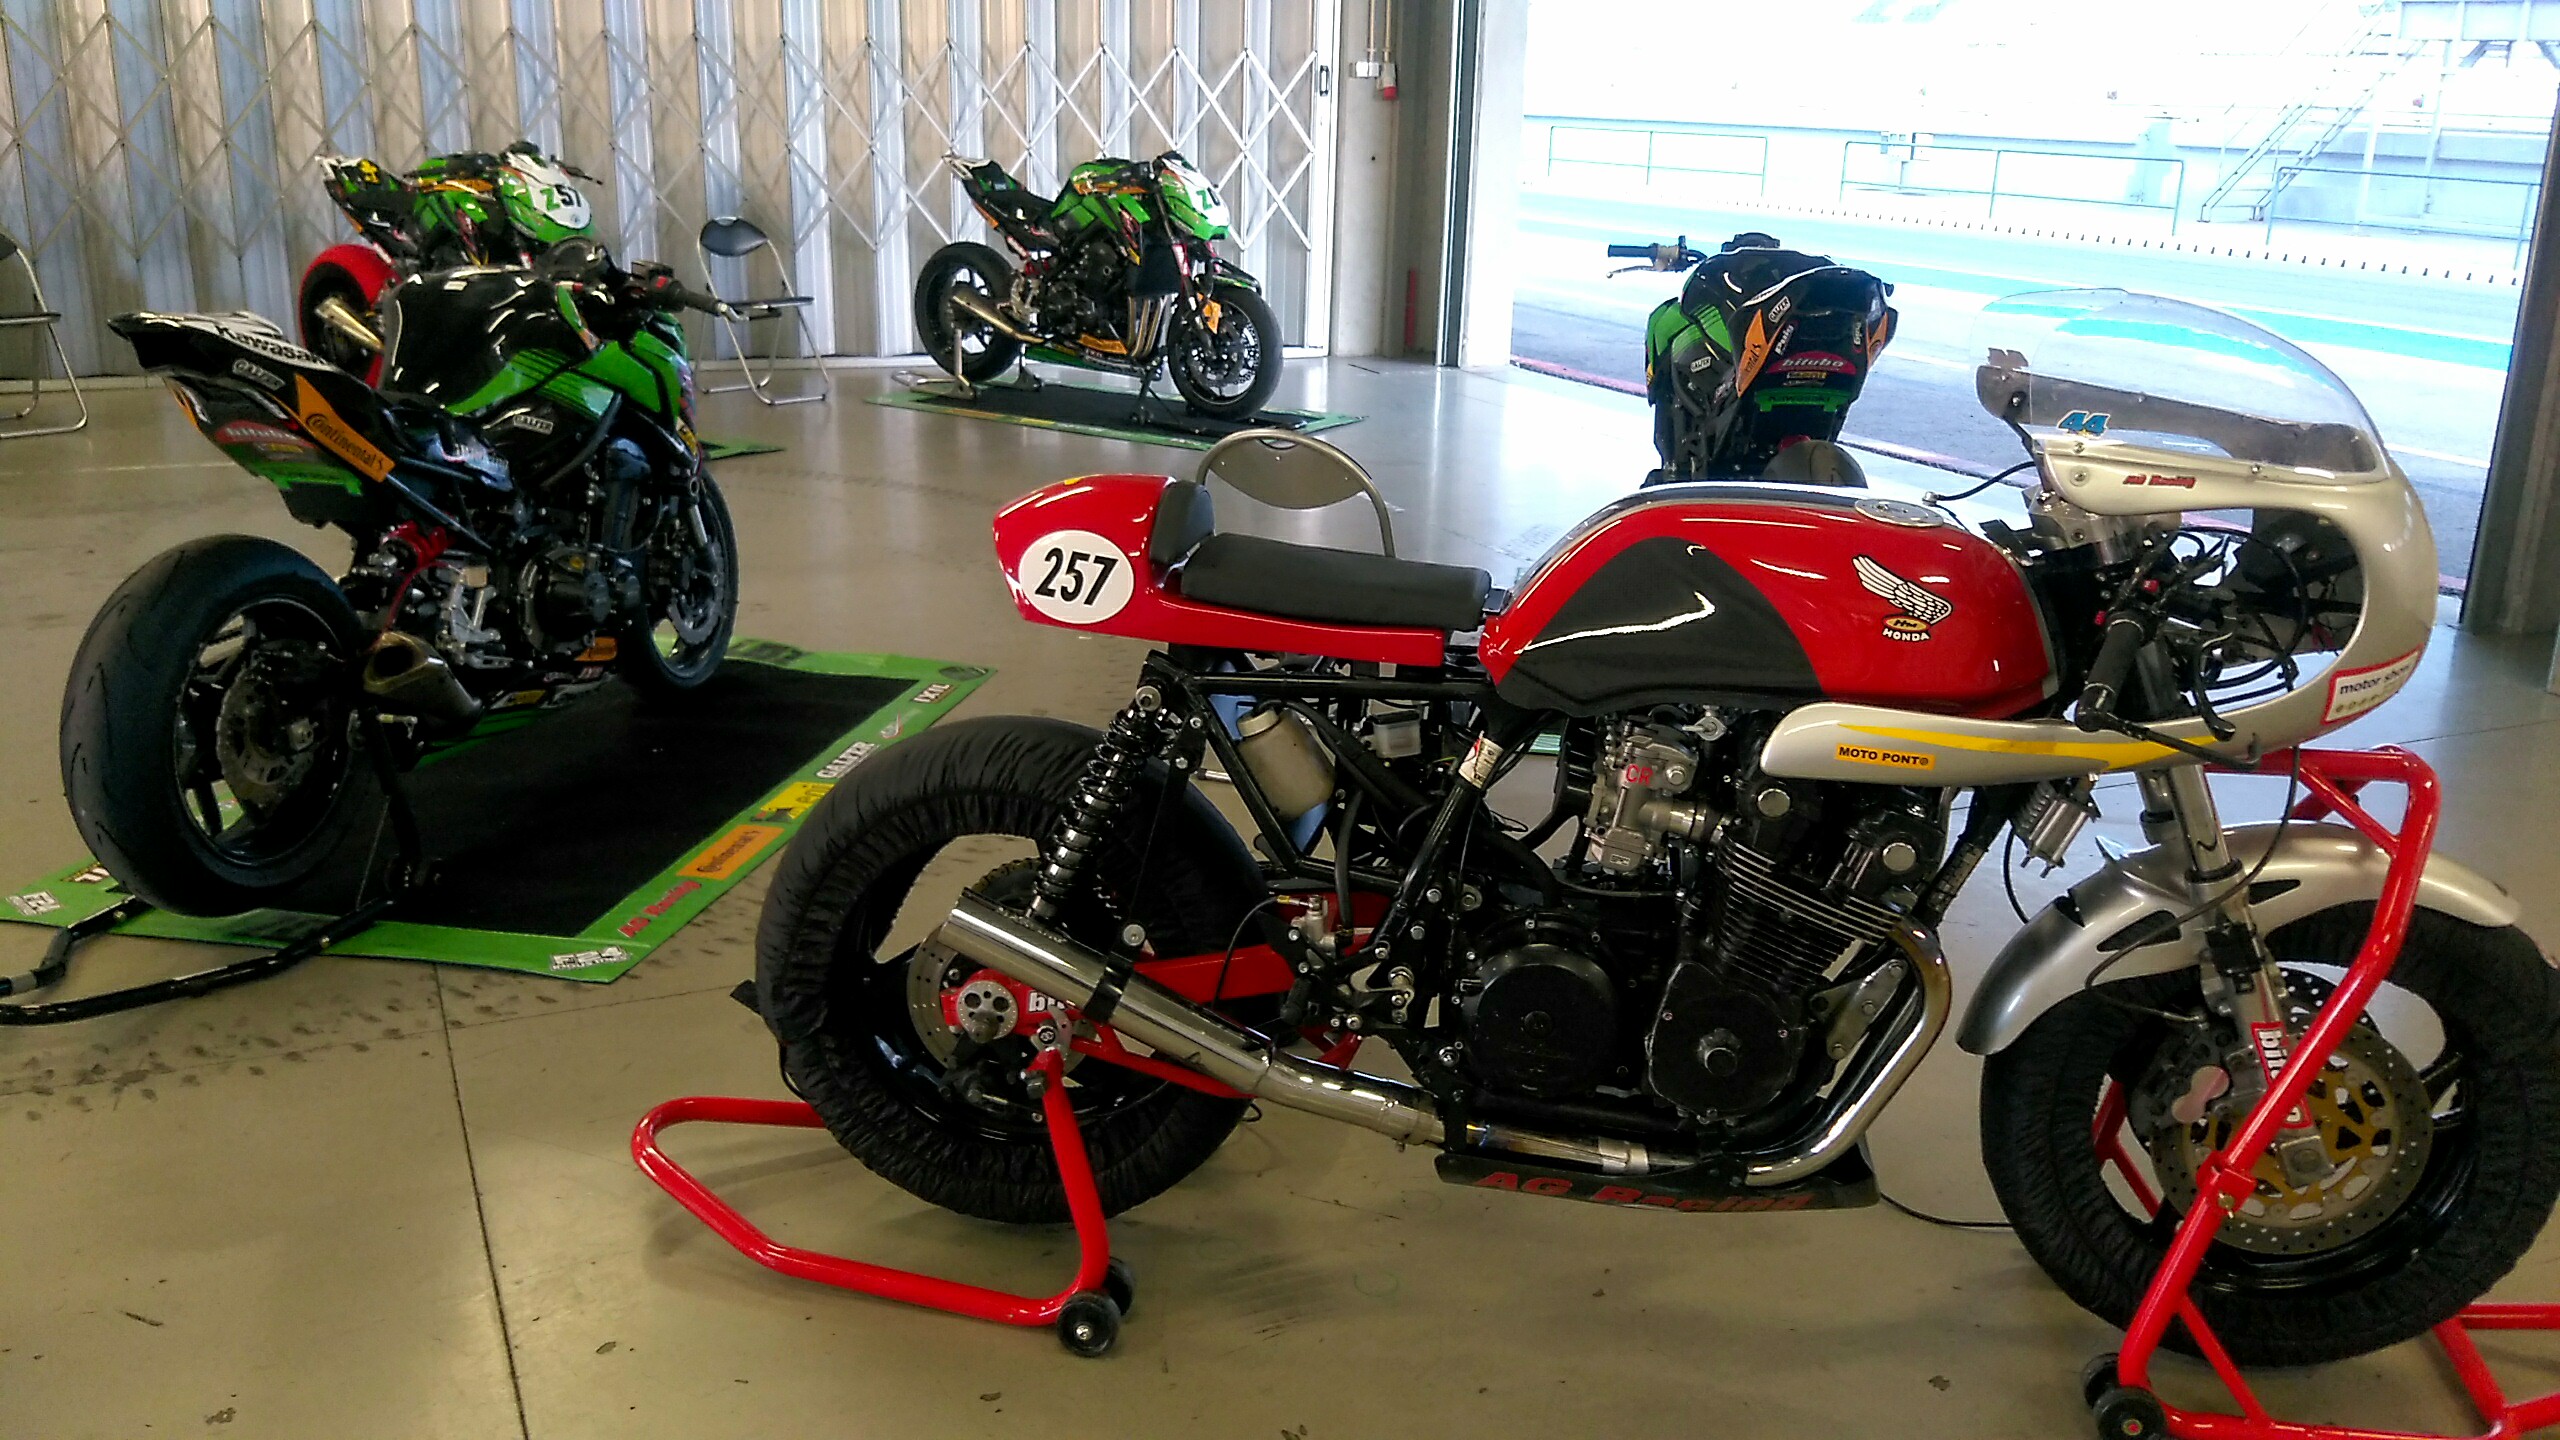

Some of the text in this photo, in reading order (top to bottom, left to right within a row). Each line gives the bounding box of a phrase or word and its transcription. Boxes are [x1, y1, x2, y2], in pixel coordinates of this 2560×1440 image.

[2058, 411, 2110, 437] 44
[305, 412, 376, 467] Continental
[1034, 547, 1119, 606] 257
[1882, 628, 1930, 642] HONDA
[913, 683, 951, 703] IXIL
[2340, 677, 2381, 694] motor
[1839, 746, 1878, 760] MOTO
[1625, 763, 1654, 785] CR
[1475, 1172, 1573, 1196] AG
